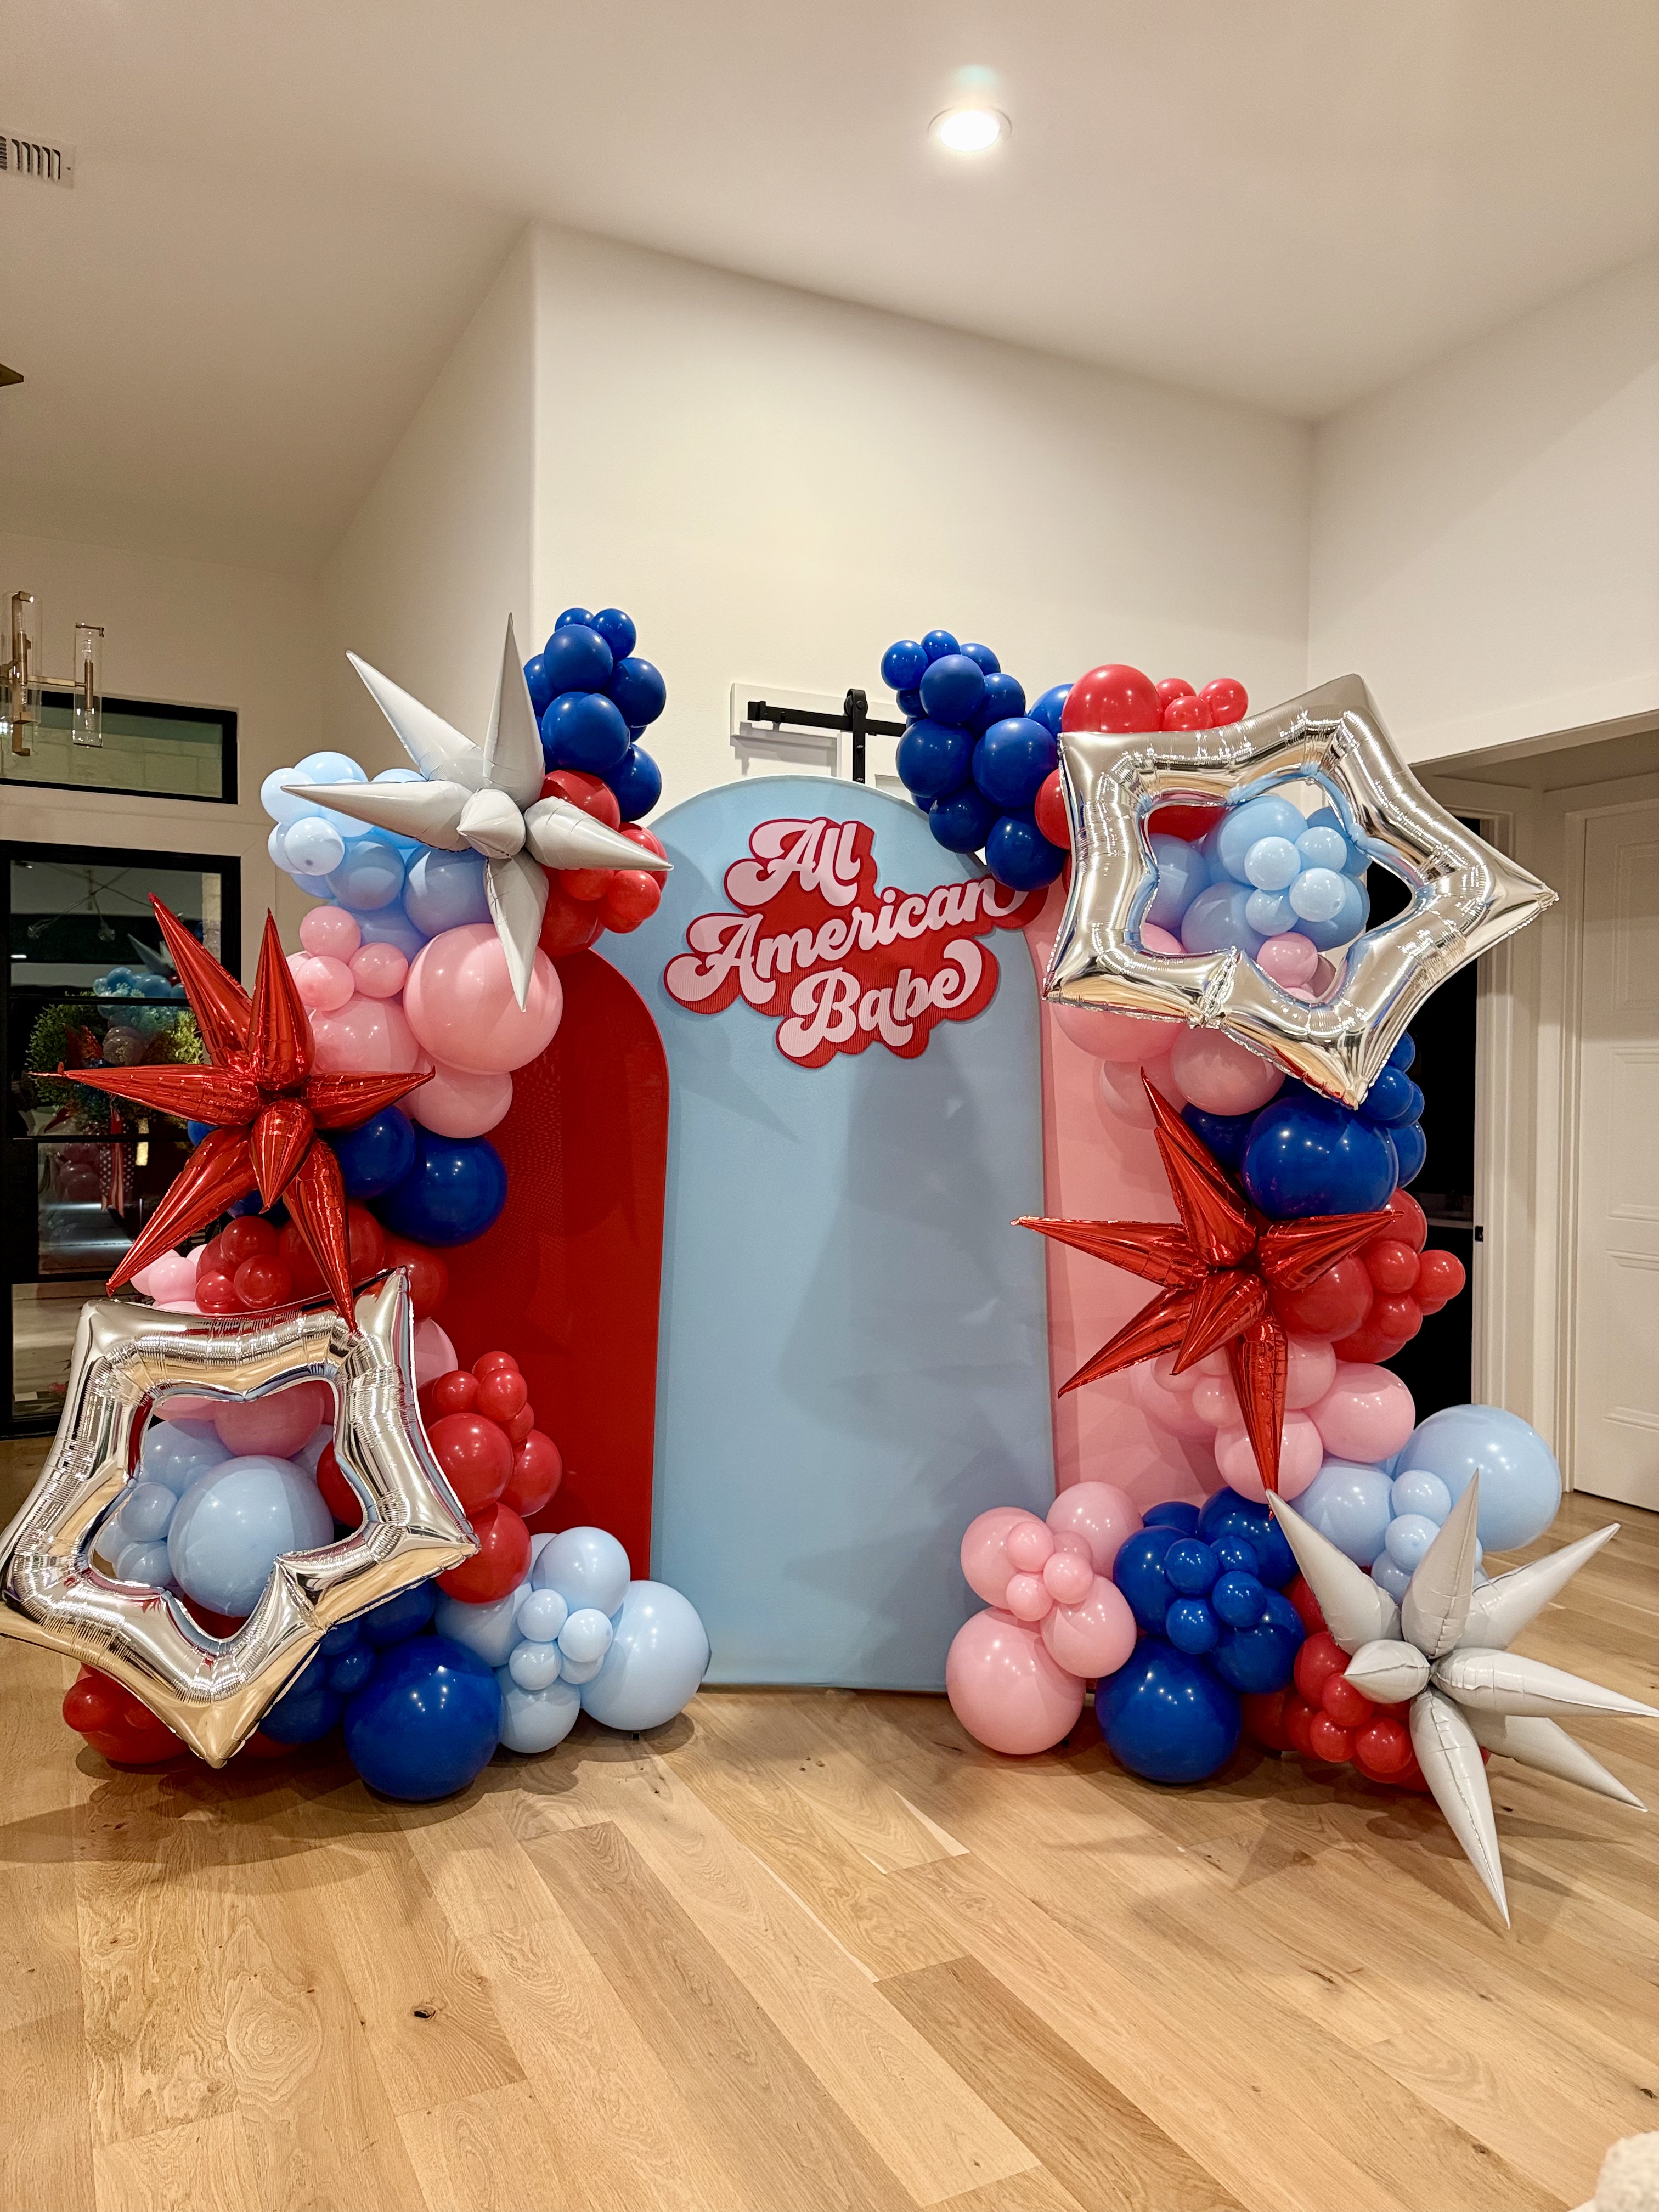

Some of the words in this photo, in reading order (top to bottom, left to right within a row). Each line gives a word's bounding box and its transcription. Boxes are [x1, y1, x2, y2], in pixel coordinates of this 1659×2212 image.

[727, 821, 861, 907] All
[667, 878, 1029, 1005] American
[779, 939, 983, 1058] Babe
